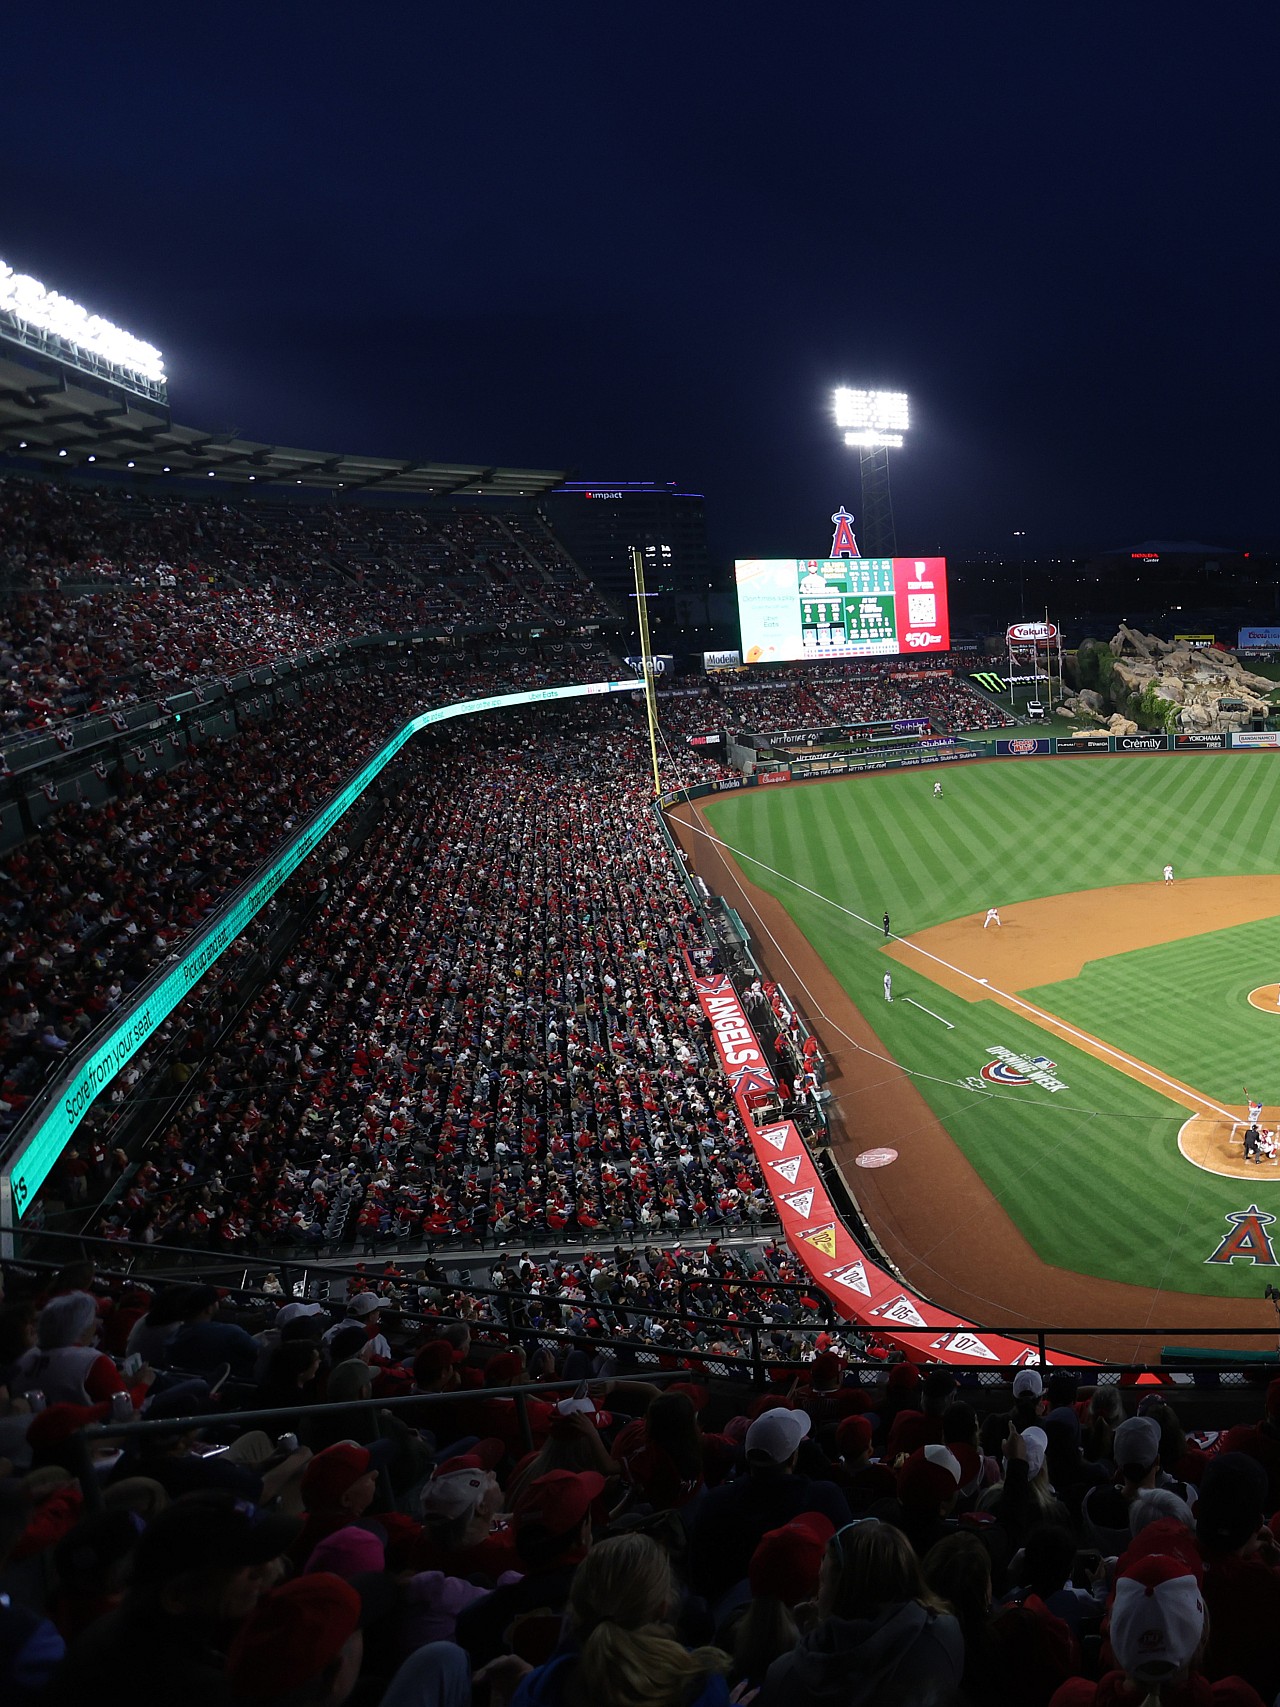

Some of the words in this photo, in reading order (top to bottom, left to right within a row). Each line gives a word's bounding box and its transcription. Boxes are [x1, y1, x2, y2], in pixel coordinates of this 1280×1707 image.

[592, 491, 623, 499] impact
[1017, 627, 1050, 635] Yakult
[708, 654, 736, 664] Modelo
[542, 690, 559, 699] Eats
[1122, 738, 1162, 750] Crèmily
[719, 780, 740, 791] Modelo
[183, 961, 199, 986] Pick
[705, 997, 760, 1065] ANGELS
[985, 1045, 1038, 1074] OPENING
[1027, 1070, 1070, 1093] WEEK
[65, 1080, 91, 1125] Score
[88, 1055, 115, 1091] from
[112, 1036, 134, 1072] your
[812, 1231, 832, 1246] '02
[1203, 1204, 1280, 1267] A
[842, 1270, 860, 1285] '04
[891, 1304, 914, 1320] '05
[955, 1335, 978, 1351] '07
